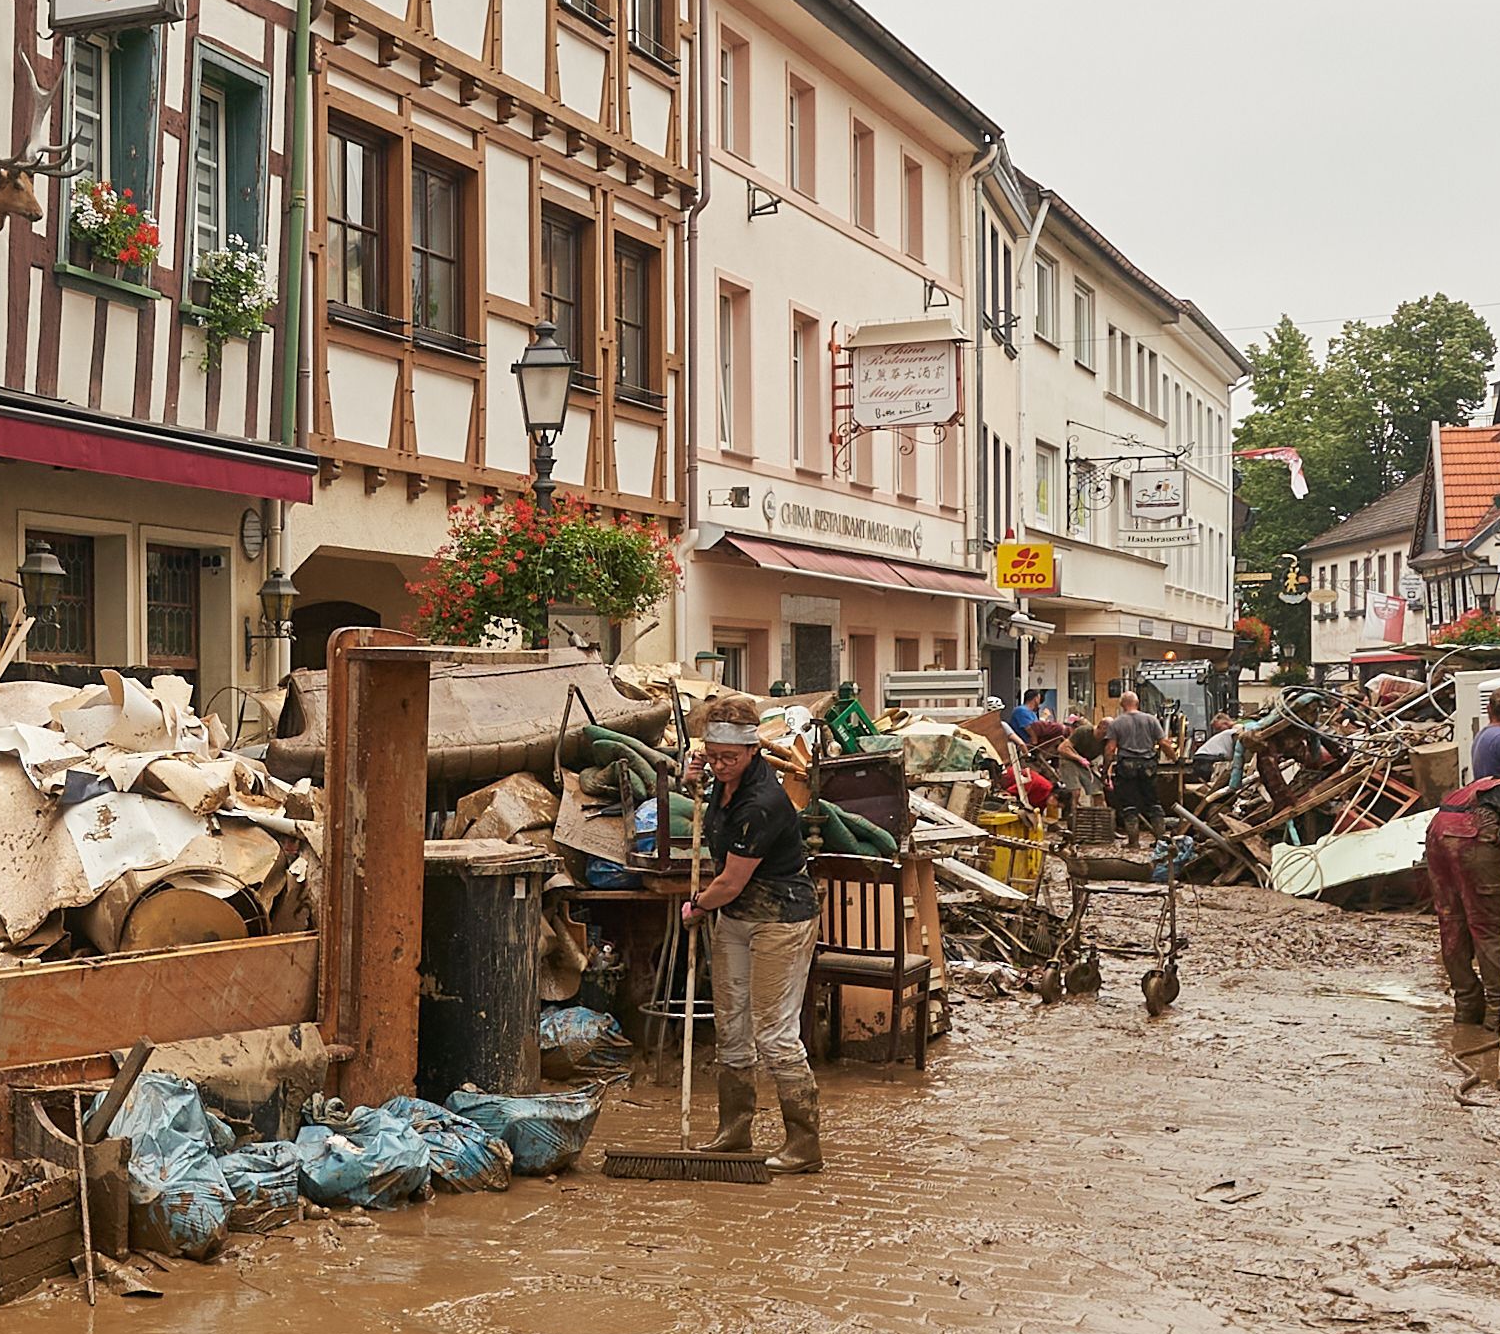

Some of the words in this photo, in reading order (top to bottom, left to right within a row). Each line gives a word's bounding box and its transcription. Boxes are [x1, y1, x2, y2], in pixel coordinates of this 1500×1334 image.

[862, 352, 946, 366] Restaurant
[862, 384, 945, 401] Mayflower
[781, 502, 812, 529] CHINA
[1127, 534, 1190, 543] Hausbrauerei
[1002, 573, 1046, 584] LOTTO
